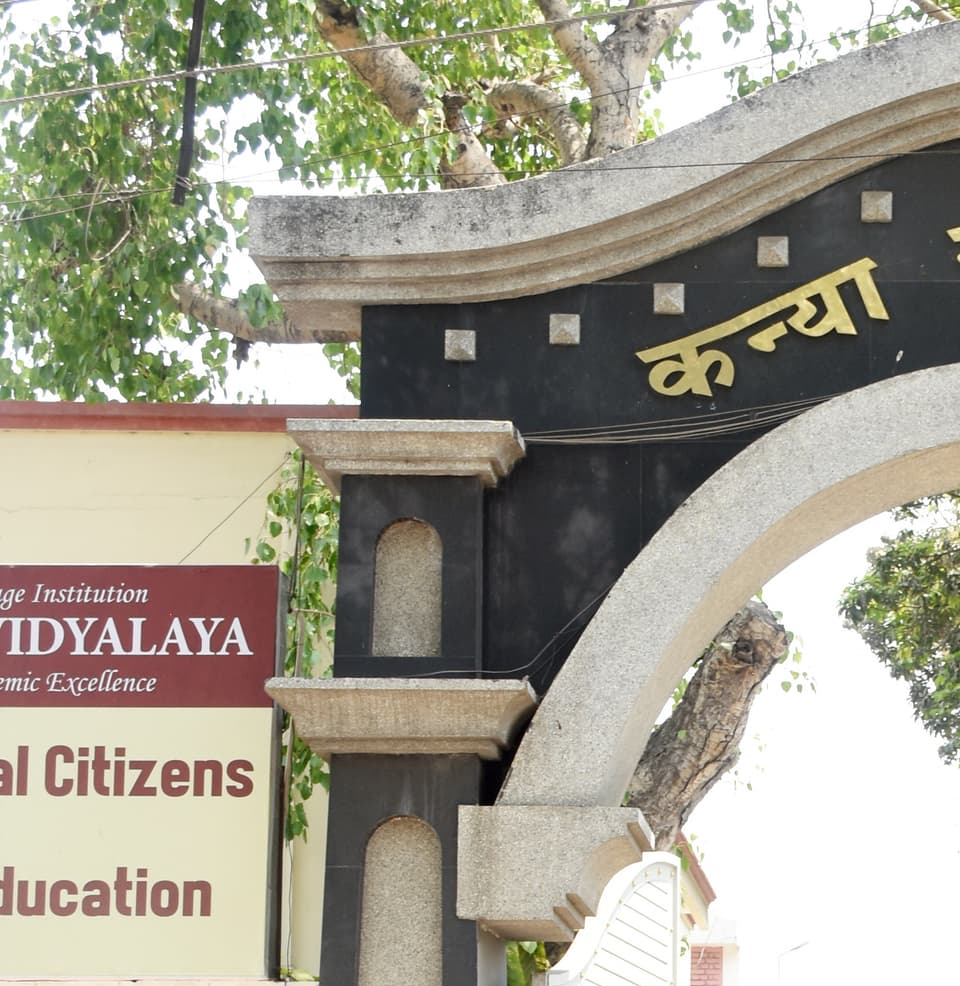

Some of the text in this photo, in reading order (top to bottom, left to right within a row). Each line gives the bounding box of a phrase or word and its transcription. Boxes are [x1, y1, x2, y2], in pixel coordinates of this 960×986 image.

[634, 256, 890, 397] कन्या
[32, 582, 149, 604] Institution
[0, 616, 254, 656] IDYALAYA
[46, 669, 157, 696] Excellence
[45, 744, 254, 797] Citizens
